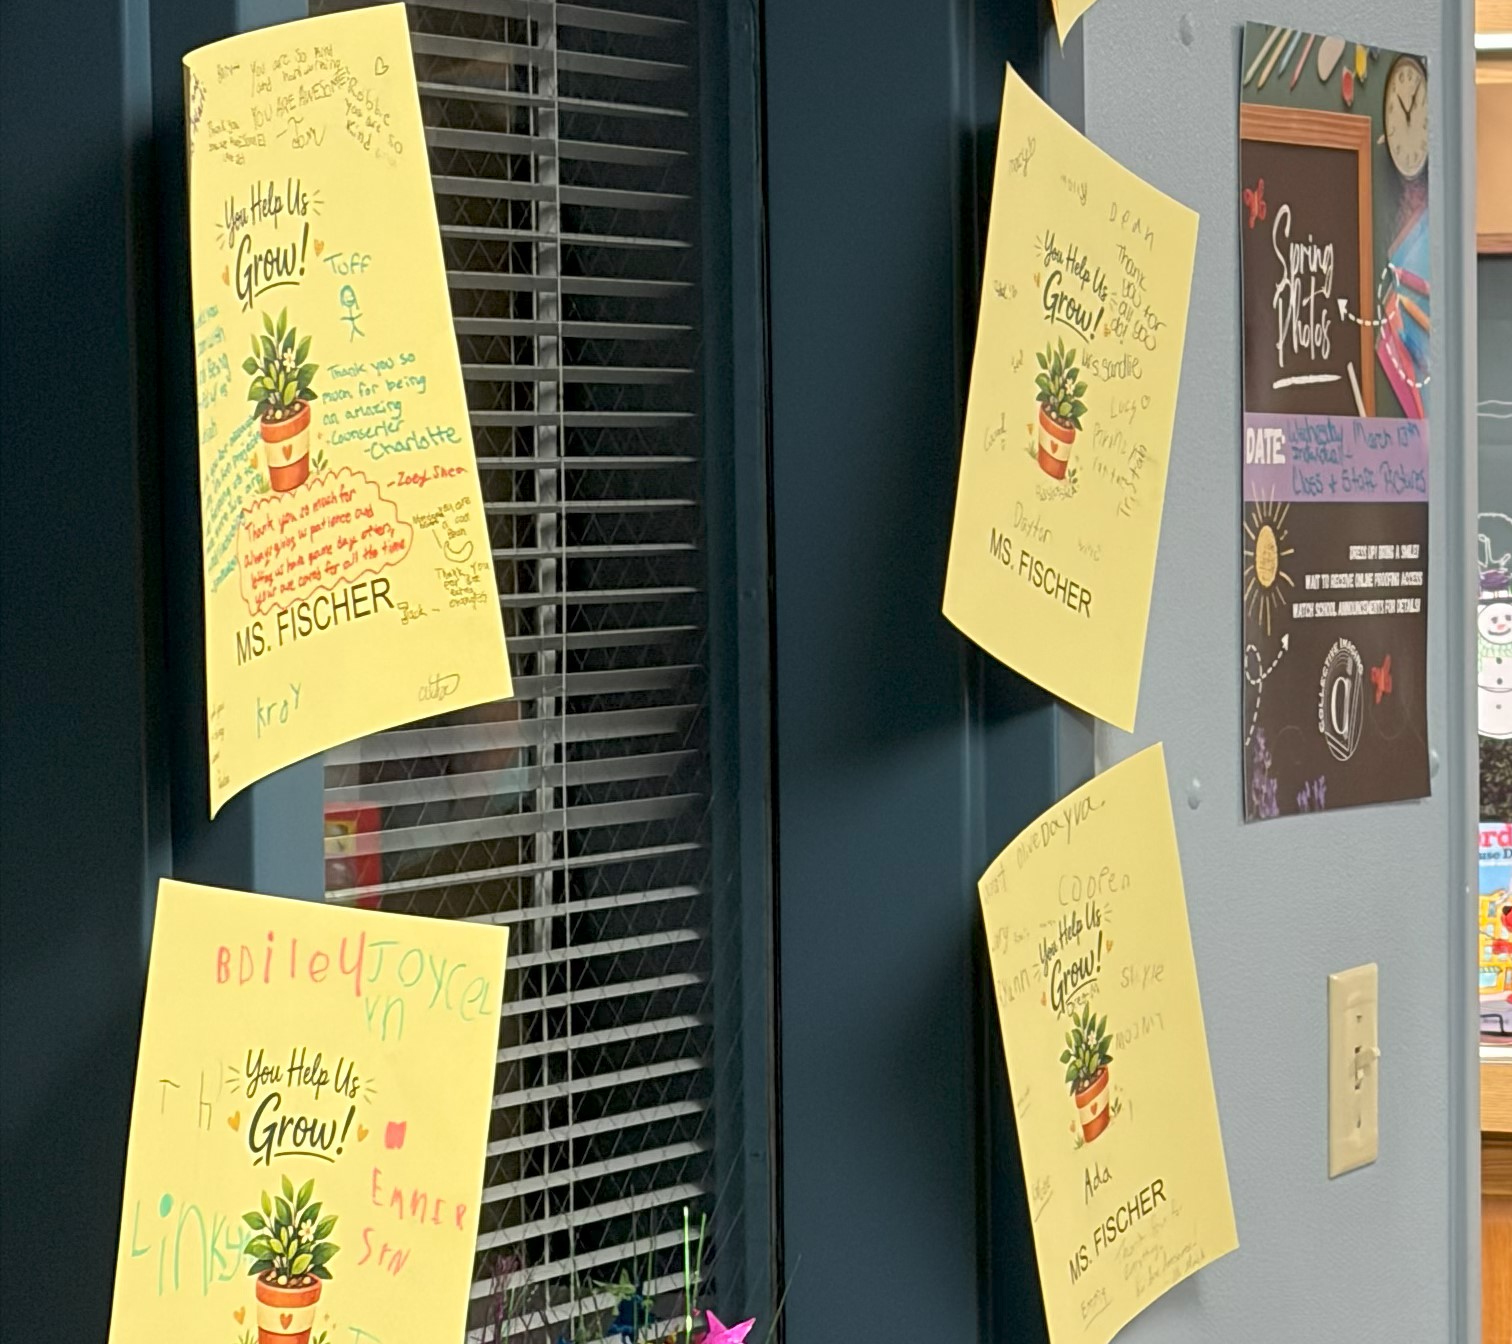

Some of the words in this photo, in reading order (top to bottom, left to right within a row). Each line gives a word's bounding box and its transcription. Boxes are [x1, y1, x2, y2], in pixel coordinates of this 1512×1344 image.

[224, 194, 248, 249] You
[250, 179, 283, 229] Help
[287, 177, 311, 217] Us
[236, 222, 310, 313] Grow!
[1045, 230, 1064, 268] You
[1066, 243, 1090, 292] Help
[1092, 266, 1108, 301] Us
[1273, 204, 1334, 308] Spring
[1043, 270, 1105, 340] Grow!
[1275, 275, 1331, 367] Photos
[327, 363, 366, 380] Thank
[370, 357, 394, 376] you
[385, 375, 426, 394] being
[345, 400, 402, 421] amazing
[245, 513, 275, 542] Thank
[279, 512, 297, 534] you
[340, 483, 356, 502] for
[310, 512, 351, 543] patience
[990, 527, 1014, 570] MS.
[1018, 549, 1092, 619] FISCHER
[237, 628, 272, 666] MS.
[277, 578, 394, 645] FISCHER
[1319, 641, 1338, 733] COLLECTIVE
[1339, 637, 1364, 676] IMAGING
[1039, 941, 1059, 977] You
[1058, 910, 1083, 946] Help
[1085, 901, 1102, 928] Us
[1050, 929, 1103, 1020] Grow!
[245, 1048, 283, 1098] You
[287, 1046, 329, 1099] Help
[335, 1057, 361, 1100] Us
[249, 1091, 356, 1166] Grow!
[1084, 1163, 1113, 1205] Ada
[1069, 1245, 1093, 1285] MS.
[1093, 1178, 1167, 1257] FISCHER
